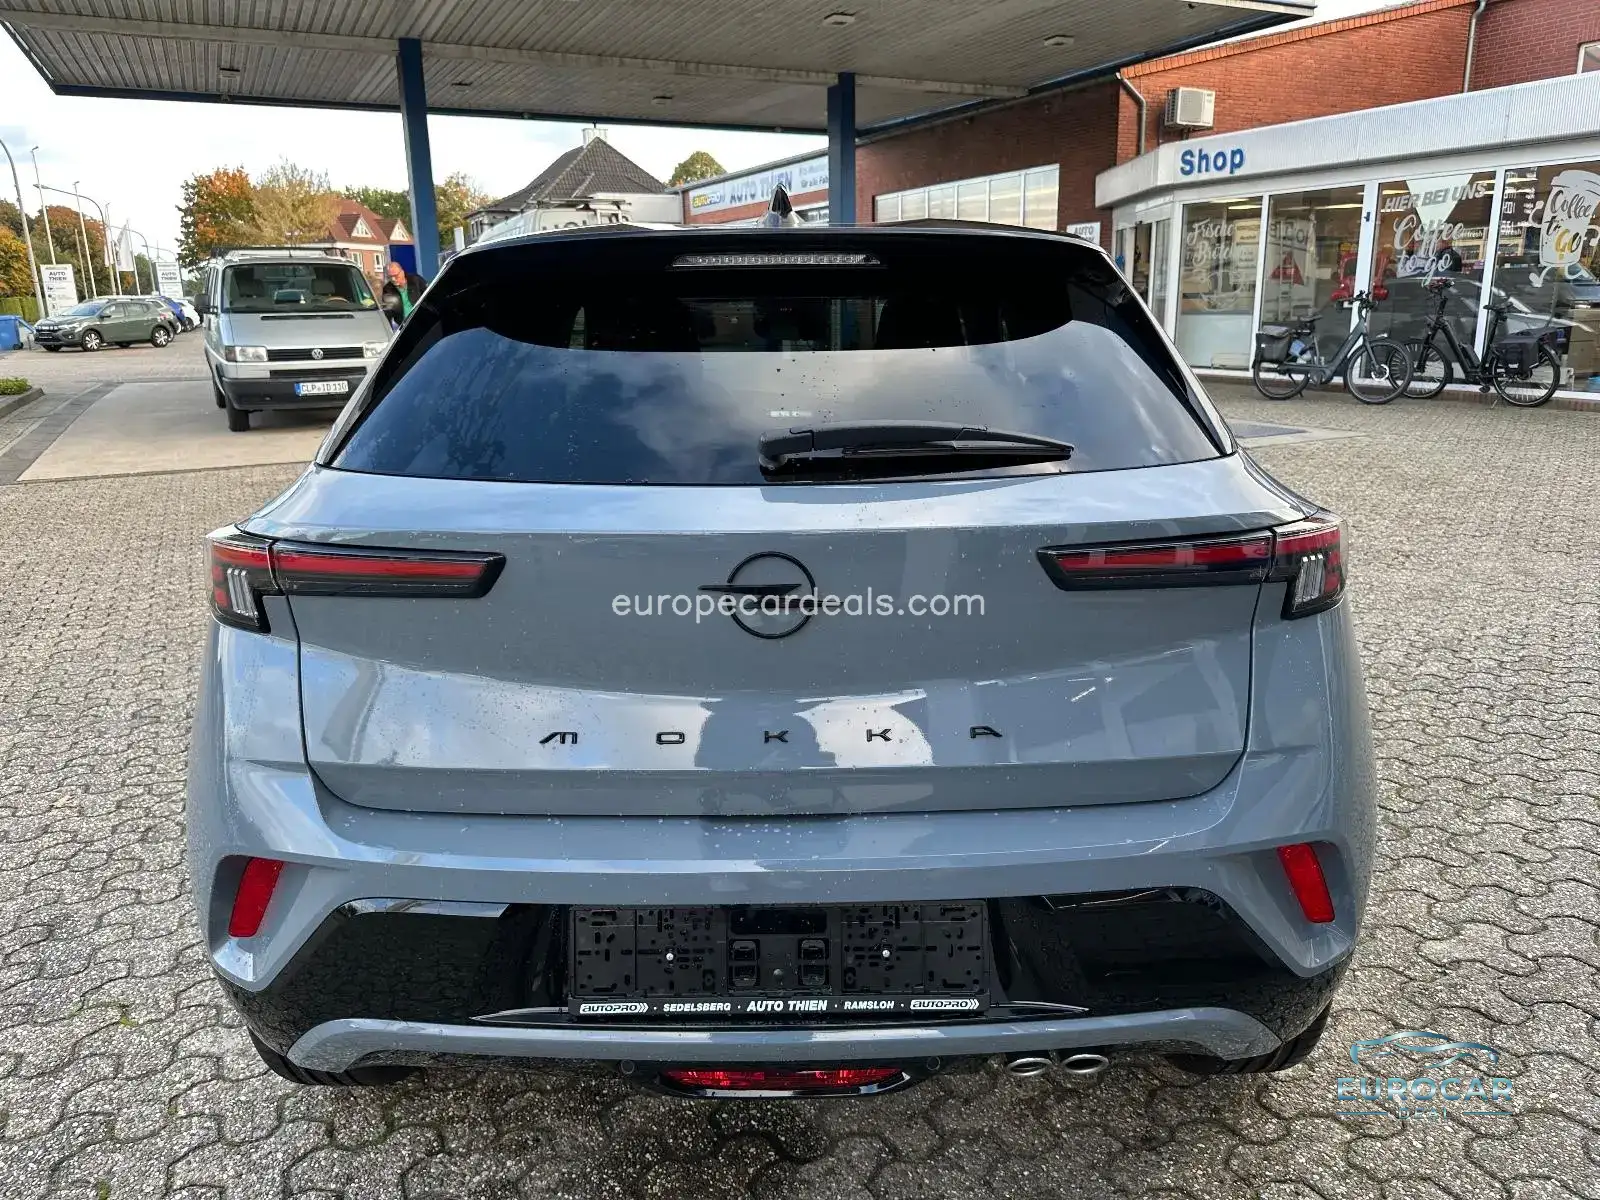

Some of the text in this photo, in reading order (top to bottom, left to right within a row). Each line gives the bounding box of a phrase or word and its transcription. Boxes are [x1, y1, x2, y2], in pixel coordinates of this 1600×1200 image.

[1179, 148, 1244, 176] Shop
[730, 181, 757, 204] AUTO
[1384, 182, 1488, 211] HIER BEI UNS
[1550, 189, 1591, 219] Coffee
[1393, 214, 1465, 259] Coffee
[1544, 215, 1562, 237] to
[539, 724, 1003, 745] MOKKA
[663, 1003, 731, 1013] SEDELSBERG
[746, 1000, 785, 1012] AUTO
[787, 999, 828, 1011] THIEN
[843, 1001, 895, 1010] RAMSLOH
